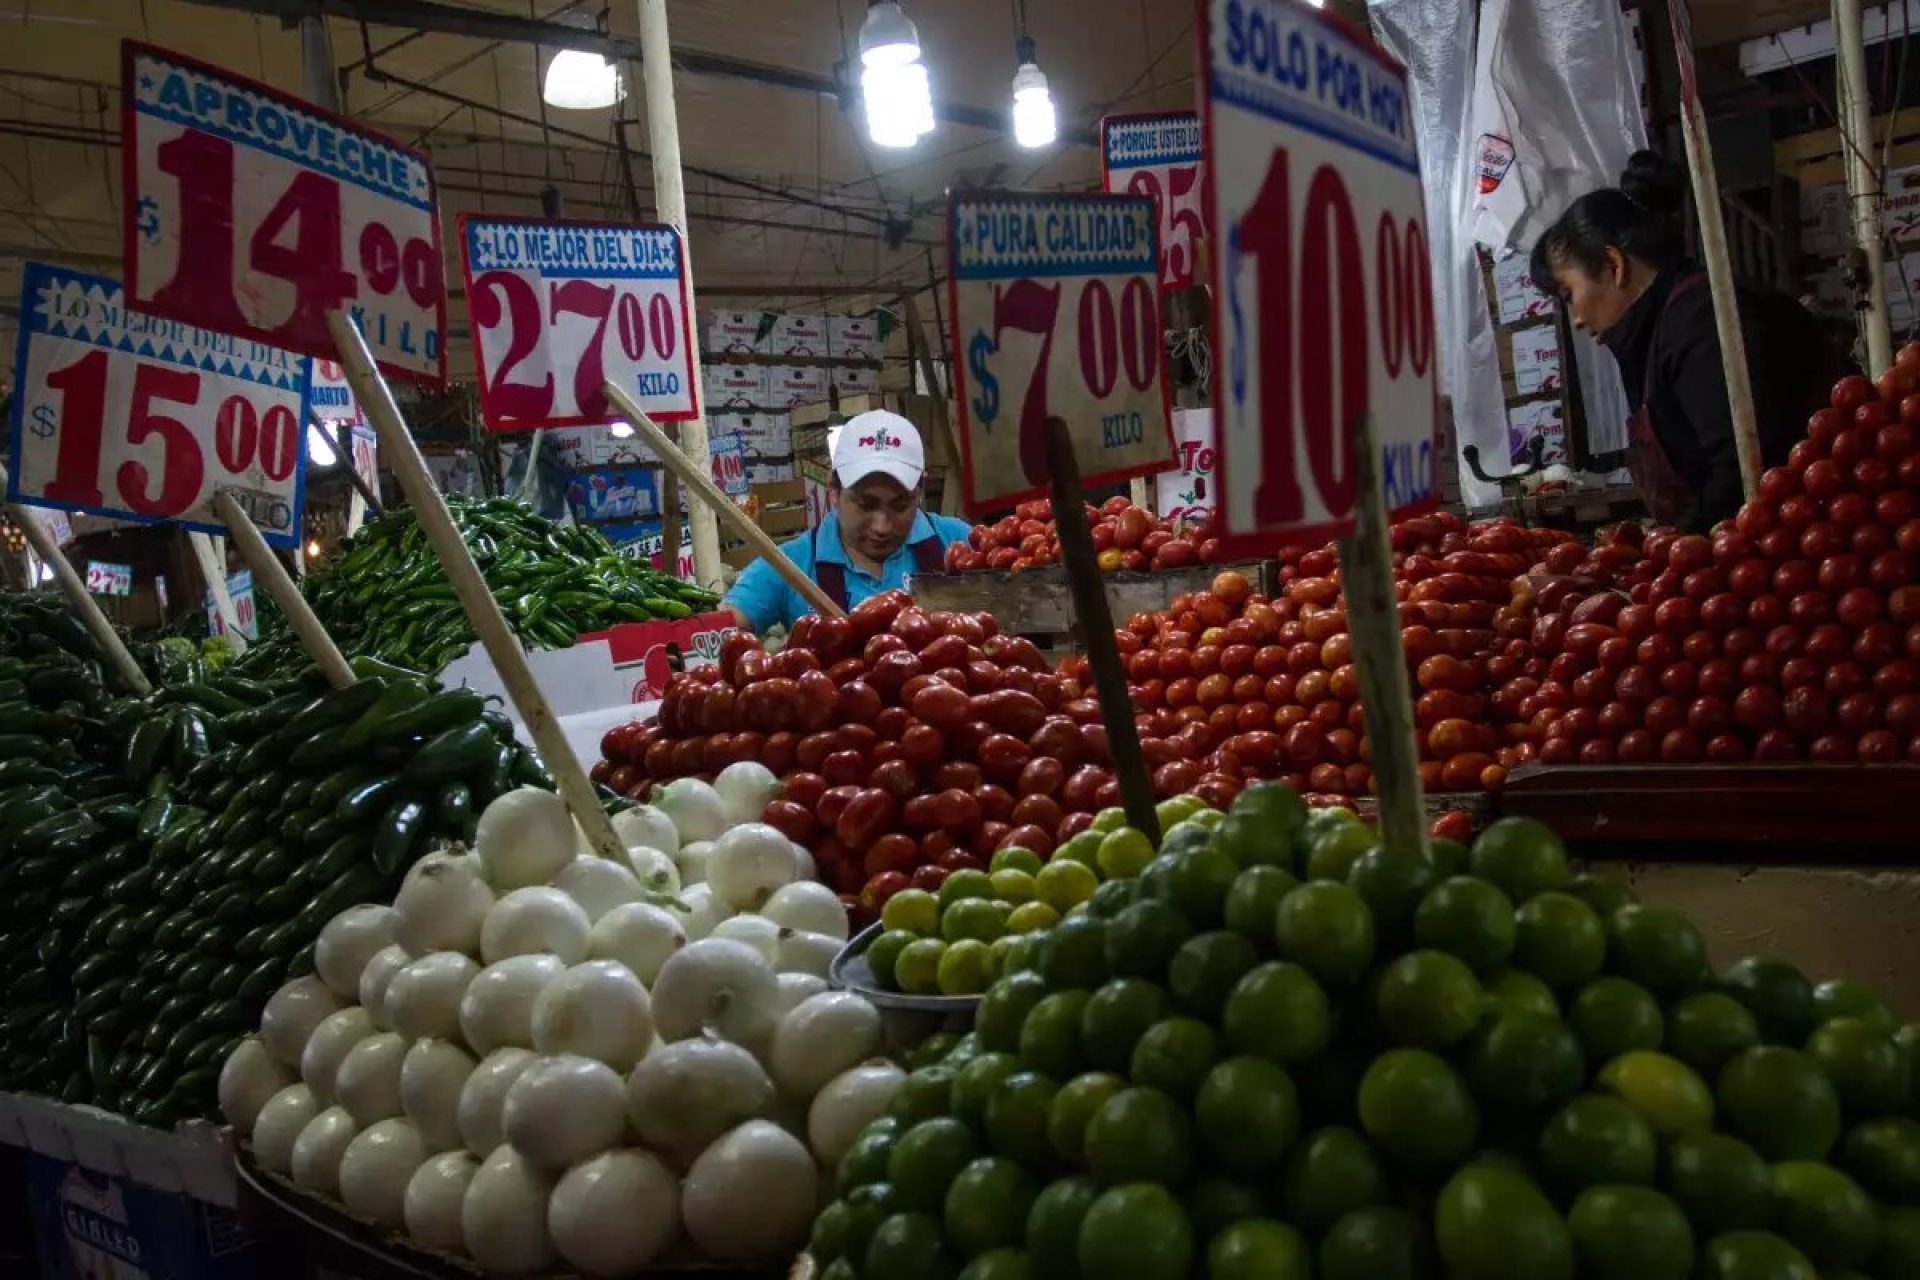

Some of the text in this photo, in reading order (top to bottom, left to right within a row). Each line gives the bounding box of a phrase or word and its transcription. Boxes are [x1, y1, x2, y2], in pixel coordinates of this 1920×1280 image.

[1226, 0, 1309, 91] SOLO
[1315, 41, 1366, 120] POR
[158, 74, 411, 190] APROVECHE
[1119, 128, 1157, 151] PORQUE
[153, 127, 358, 344] 14
[493, 232, 518, 261] LO
[525, 233, 588, 263] MEJOR
[593, 236, 628, 264] DEL
[978, 212, 1136, 254] PURA CALIDAD
[54, 293, 90, 320] LO
[99, 307, 186, 345] MEJOR
[194, 325, 242, 358] DEL
[472, 270, 676, 421] 27 00
[1240, 147, 1369, 531] 10
[1377, 210, 1433, 381] 00
[637, 371, 680, 397] KILO
[991, 277, 1062, 487] 7
[1079, 276, 1157, 399] 00
[29, 401, 57, 441] $
[43, 348, 205, 519] 15
[215, 394, 300, 482] 00
[1102, 411, 1143, 449] KILO
[1384, 440, 1433, 508] KILO
